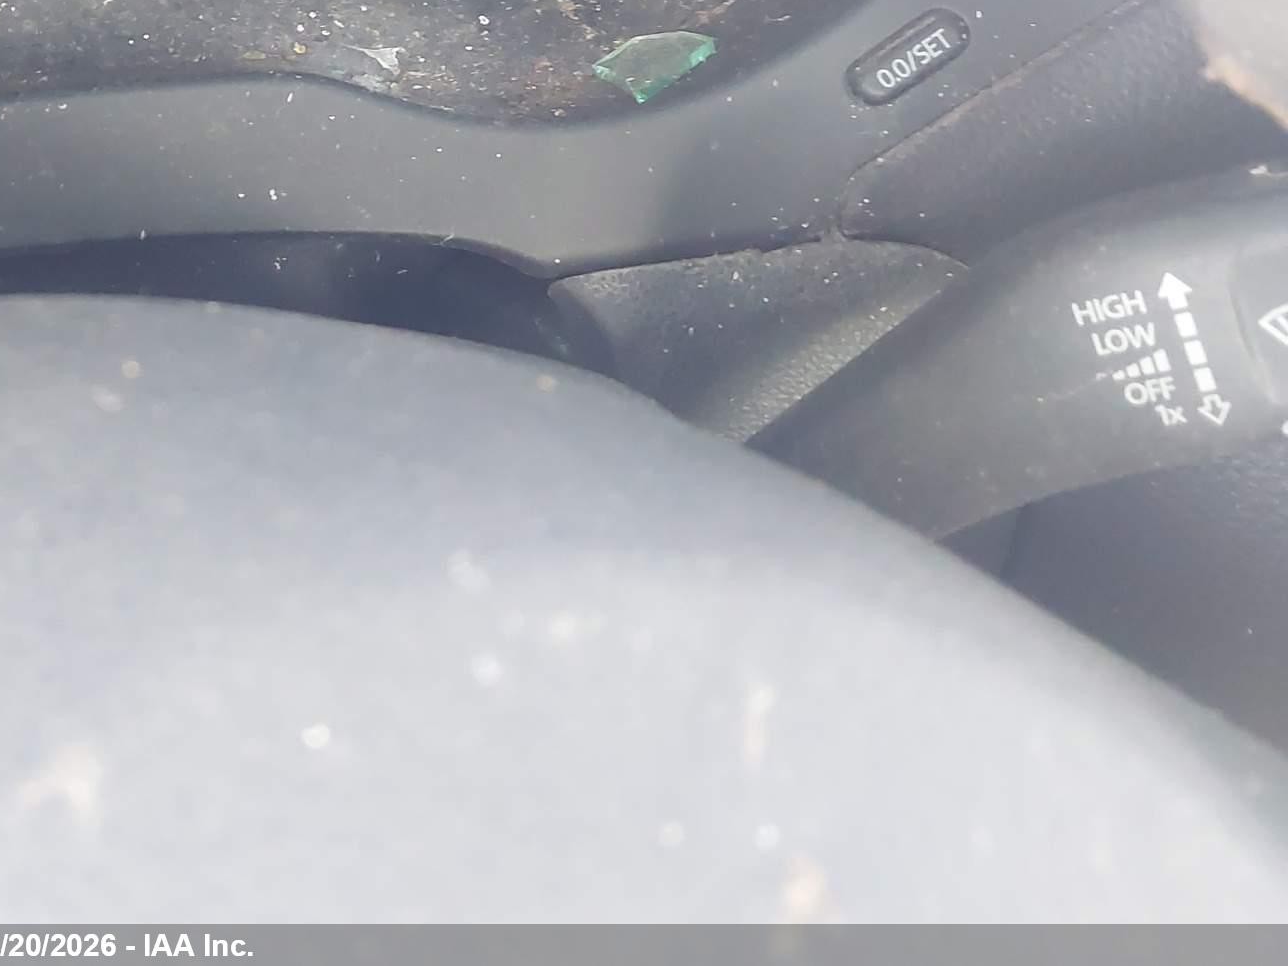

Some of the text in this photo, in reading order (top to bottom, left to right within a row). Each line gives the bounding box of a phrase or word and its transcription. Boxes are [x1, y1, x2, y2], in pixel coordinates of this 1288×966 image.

[876, 28, 952, 90] 0.0/SET
[1072, 290, 1147, 326] HIGH
[1091, 322, 1156, 357] LOW
[1124, 376, 1176, 405] OFF
[1155, 404, 1187, 426] 1x
